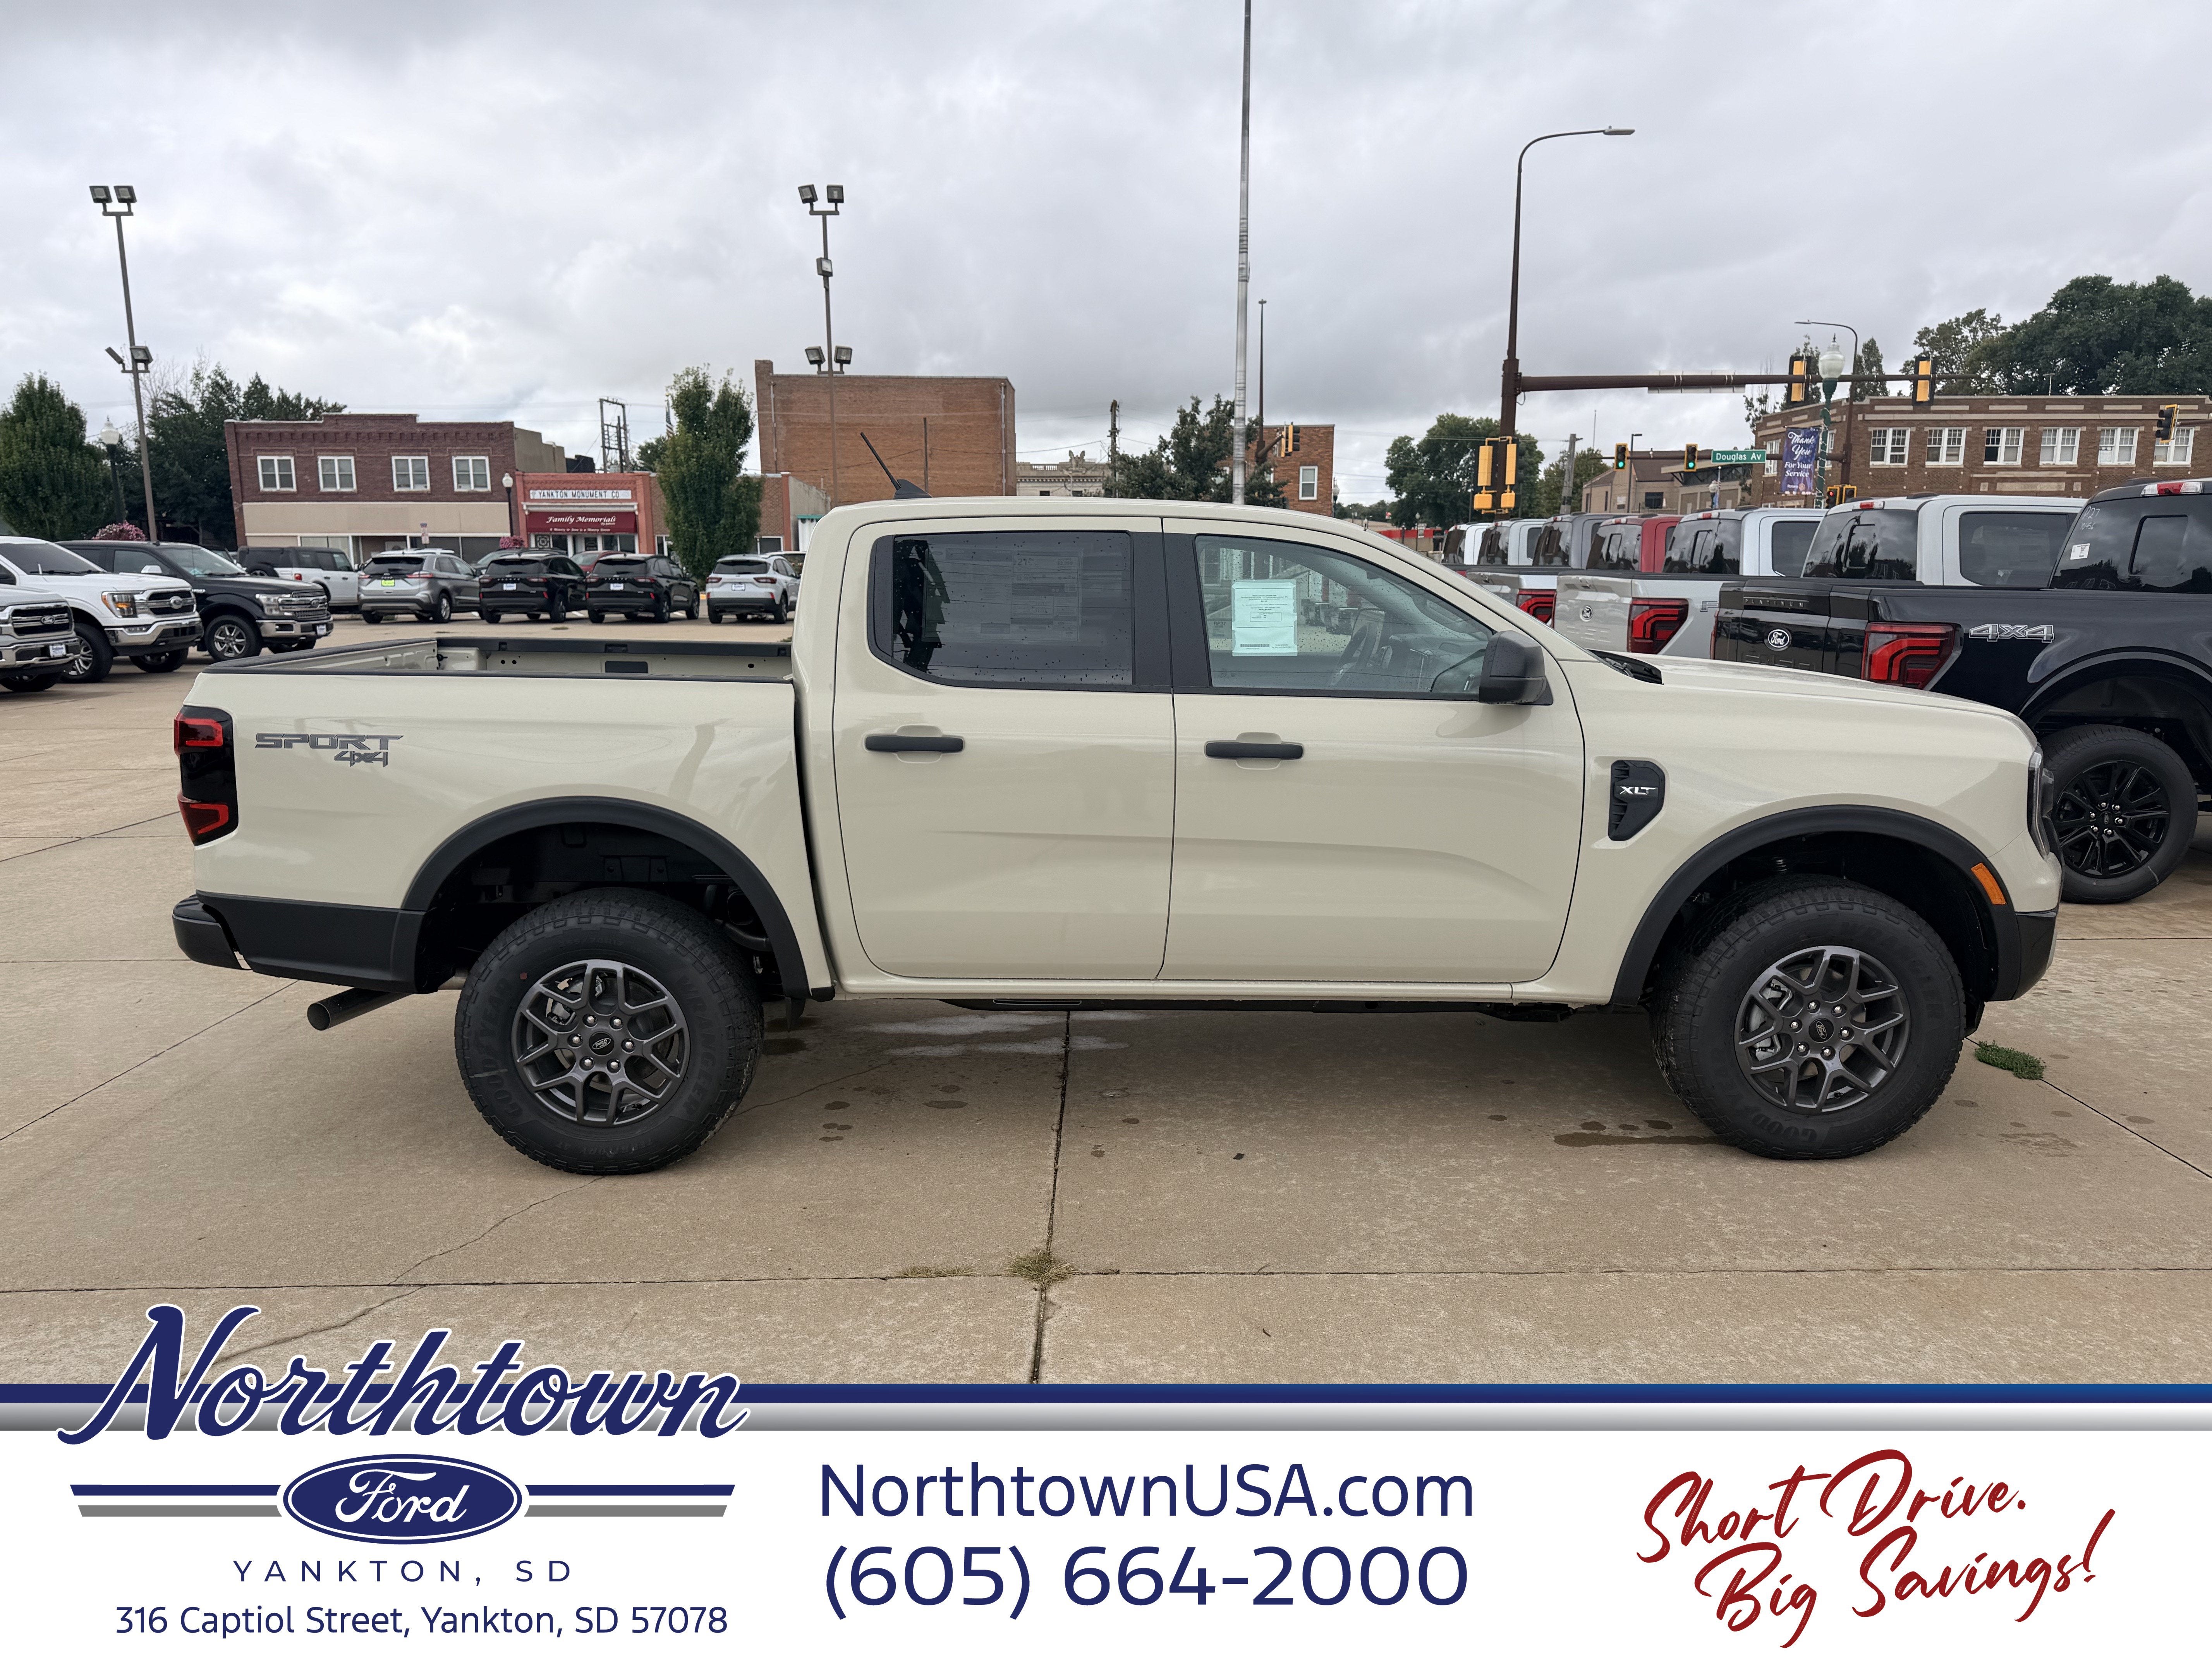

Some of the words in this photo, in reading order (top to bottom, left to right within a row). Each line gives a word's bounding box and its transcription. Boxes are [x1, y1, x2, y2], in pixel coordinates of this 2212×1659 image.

[1788, 431, 1815, 444] Thank
[1716, 453, 1747, 462] Douglas
[1792, 445, 1812, 460] You
[546, 515, 575, 524] Family
[1745, 599, 1803, 608] PLATINUM
[1771, 631, 1786, 645] Ford
[255, 733, 404, 750] SPORT
[1620, 786, 1656, 795] XLT
